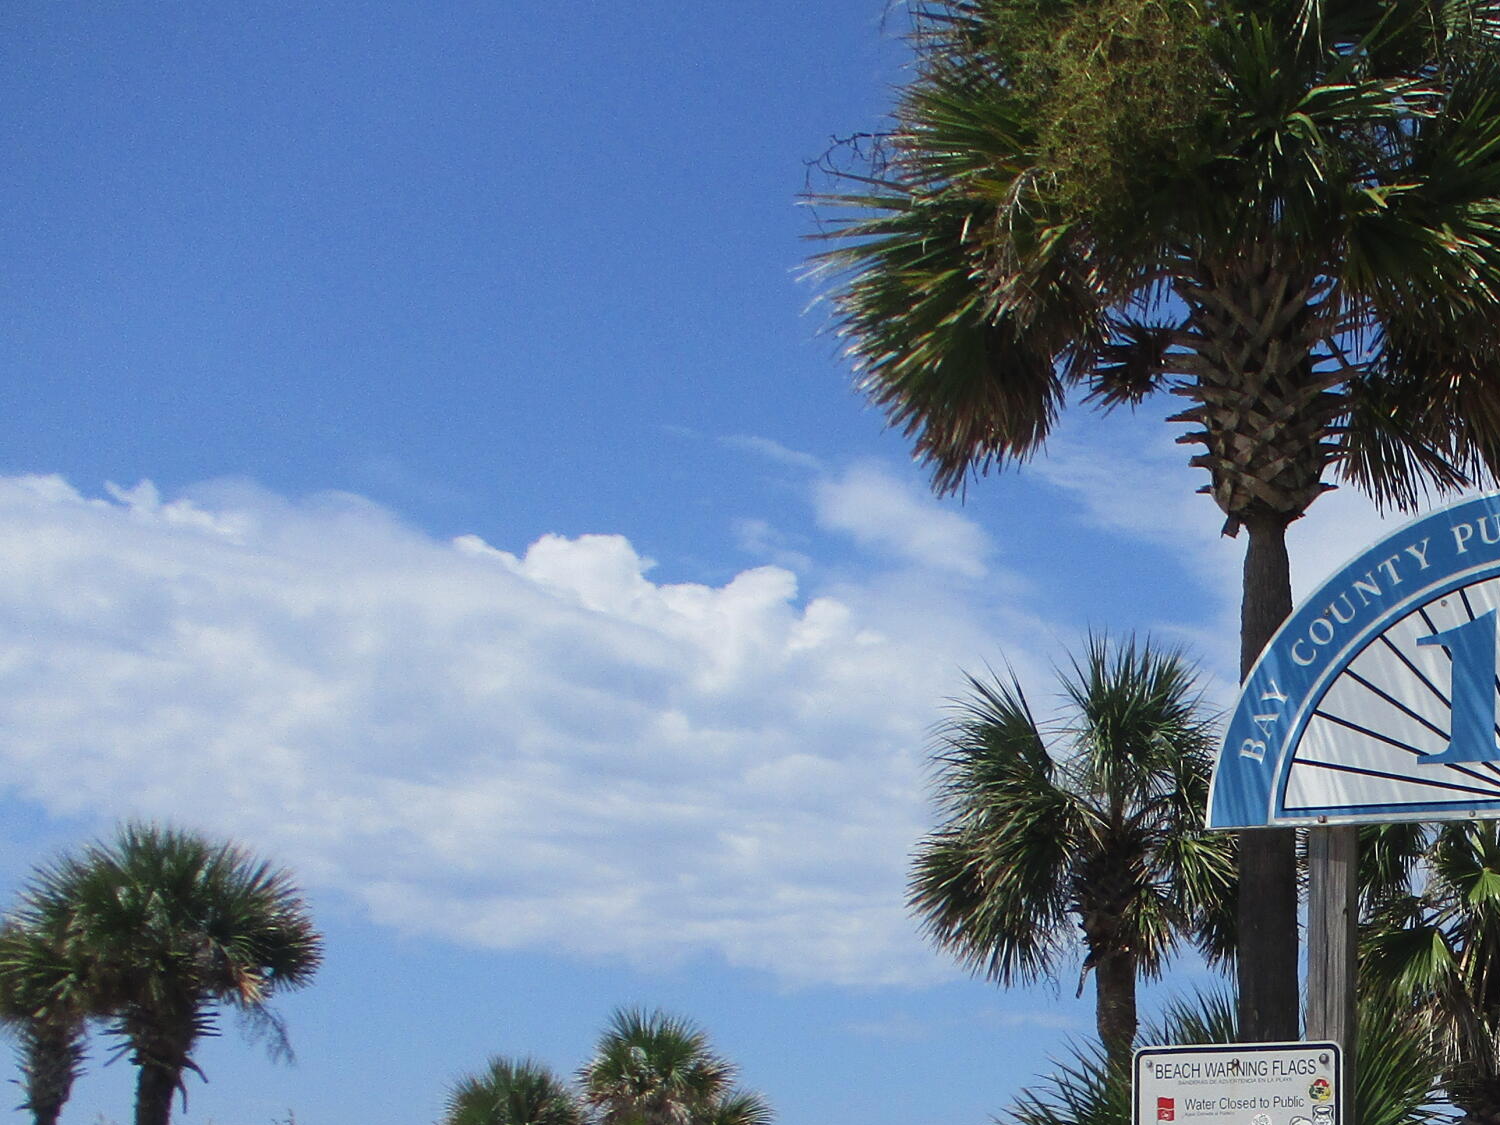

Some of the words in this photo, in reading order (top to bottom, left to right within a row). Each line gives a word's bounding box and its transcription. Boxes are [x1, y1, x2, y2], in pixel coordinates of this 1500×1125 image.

[1240, 679, 1288, 765] BAY
[1291, 538, 1431, 666] COUNTY
[1155, 1063, 1200, 1079] BEACH
[1204, 1060, 1268, 1078] WARNING
[1272, 1059, 1317, 1075] FLAGS
[1184, 1097, 1215, 1111] Water
[1219, 1096, 1257, 1110] Closed
[1259, 1097, 1269, 1109] to
[1273, 1095, 1305, 1108] Public
